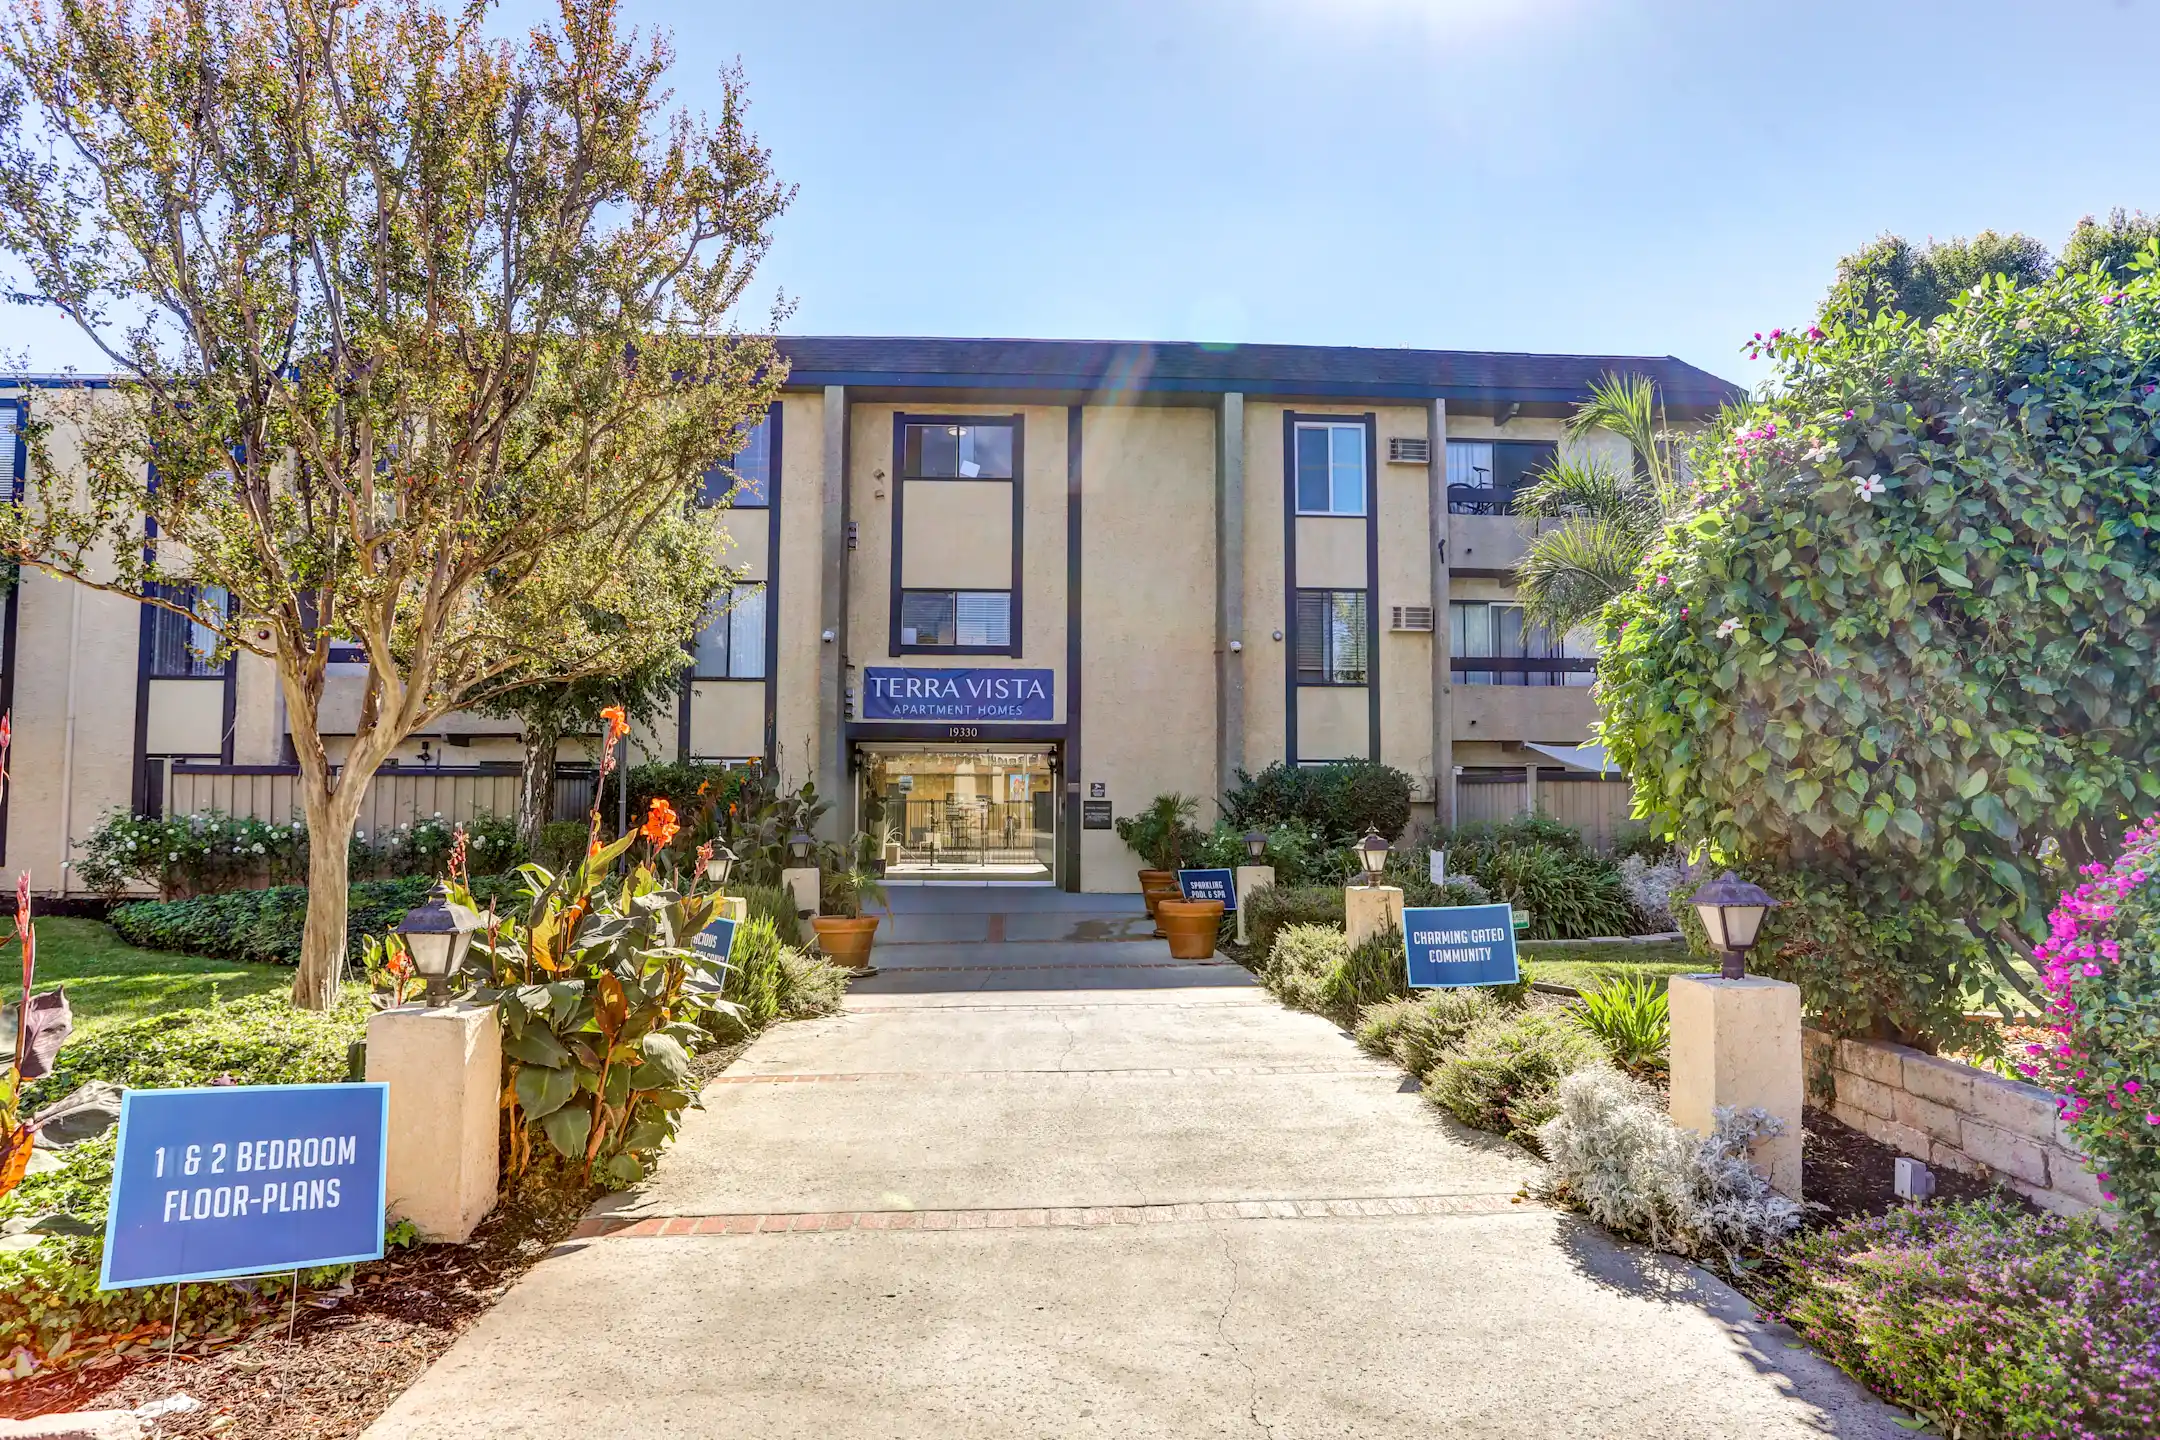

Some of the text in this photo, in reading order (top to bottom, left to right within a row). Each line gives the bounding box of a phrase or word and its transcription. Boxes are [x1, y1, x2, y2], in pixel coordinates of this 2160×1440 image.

[870, 677, 1046, 699] TERRA VISTA
[892, 704, 1023, 716] APARTMENT HOMES
[949, 727, 978, 737] 19330
[1190, 881, 1223, 889] SPARKLING
[1191, 890, 1207, 898] POOL
[1213, 890, 1226, 898] SPA
[1413, 928, 1505, 945] CHARMING GATED
[1428, 947, 1492, 963] COMMUNITY
[155, 1135, 357, 1178] 1 & 2 BEDROOM
[163, 1178, 341, 1223] FLOOR-PLANS
